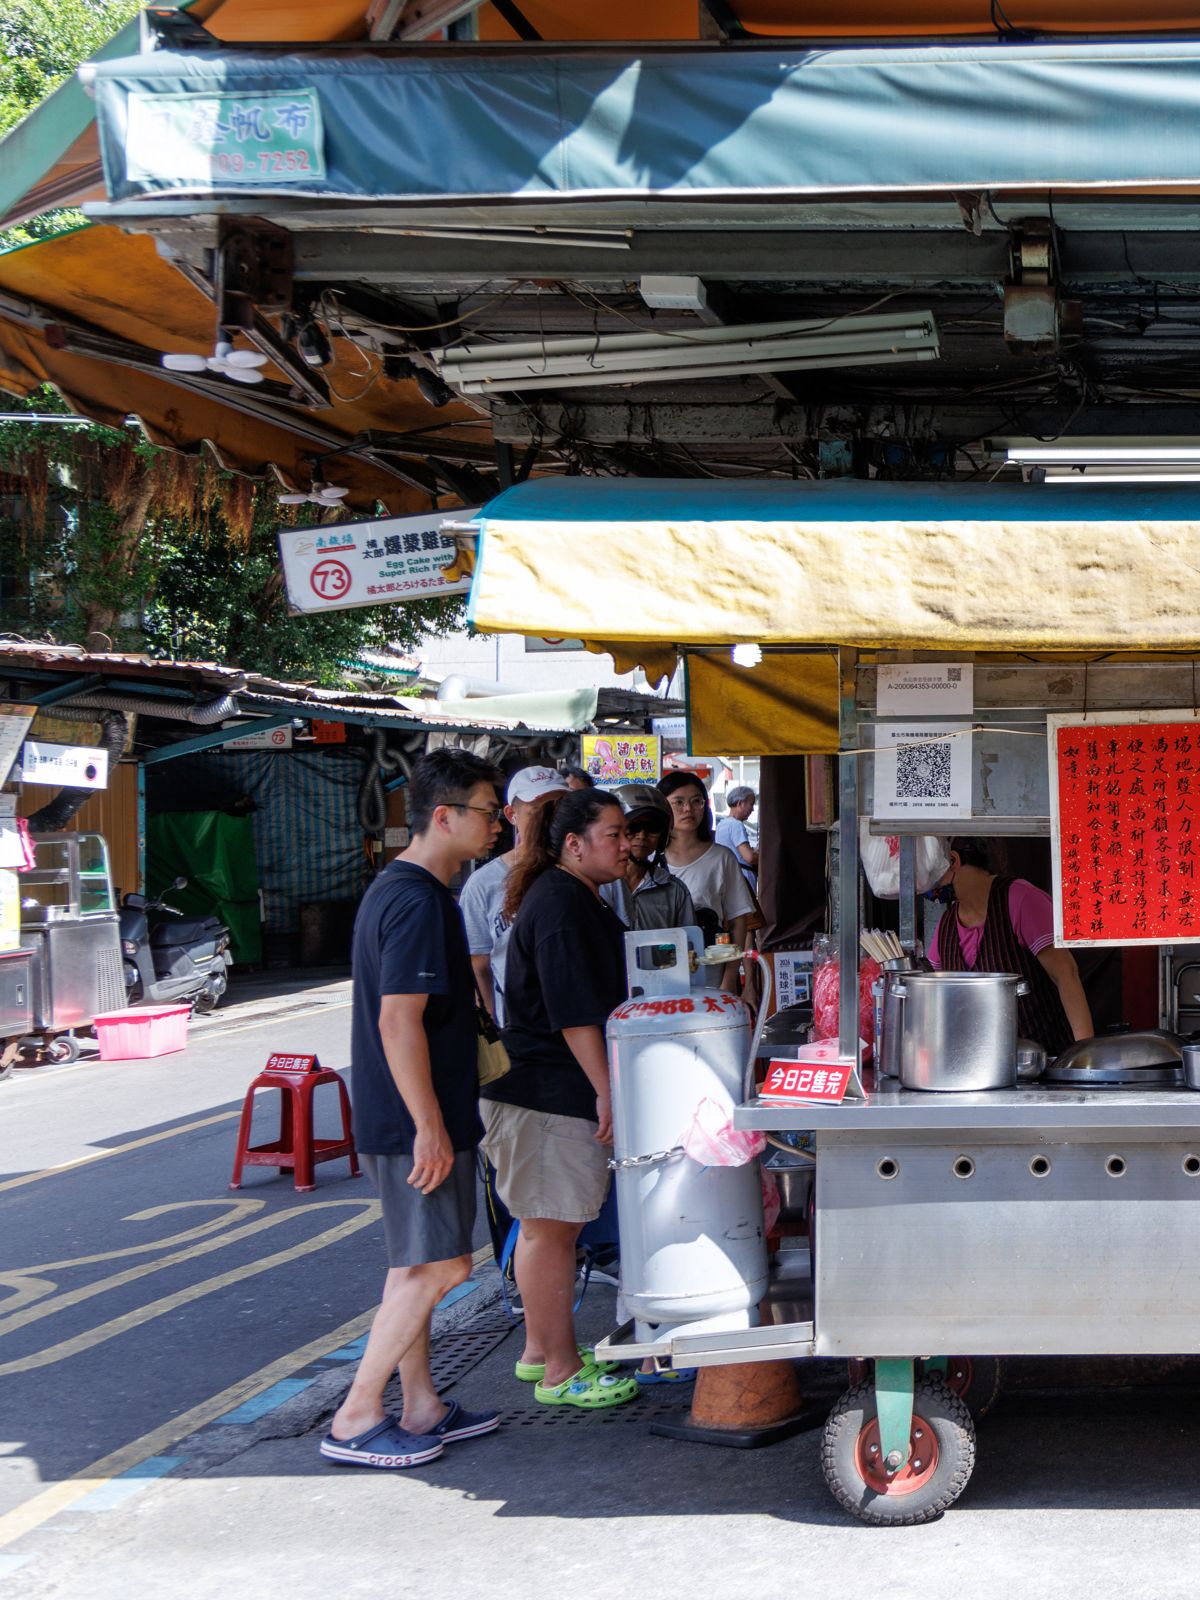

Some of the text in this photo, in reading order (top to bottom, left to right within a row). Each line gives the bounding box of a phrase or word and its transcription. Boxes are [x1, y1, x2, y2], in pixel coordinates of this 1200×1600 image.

[386, 553, 454, 570] Egg Cake with
[379, 567, 407, 578] Super
[409, 564, 430, 574] Rich
[314, 569, 346, 592] 73
[268, 1056, 311, 1071] 今日已售完
[770, 1067, 844, 1095] 今日已售完
[367, 1453, 413, 1467] crocs
